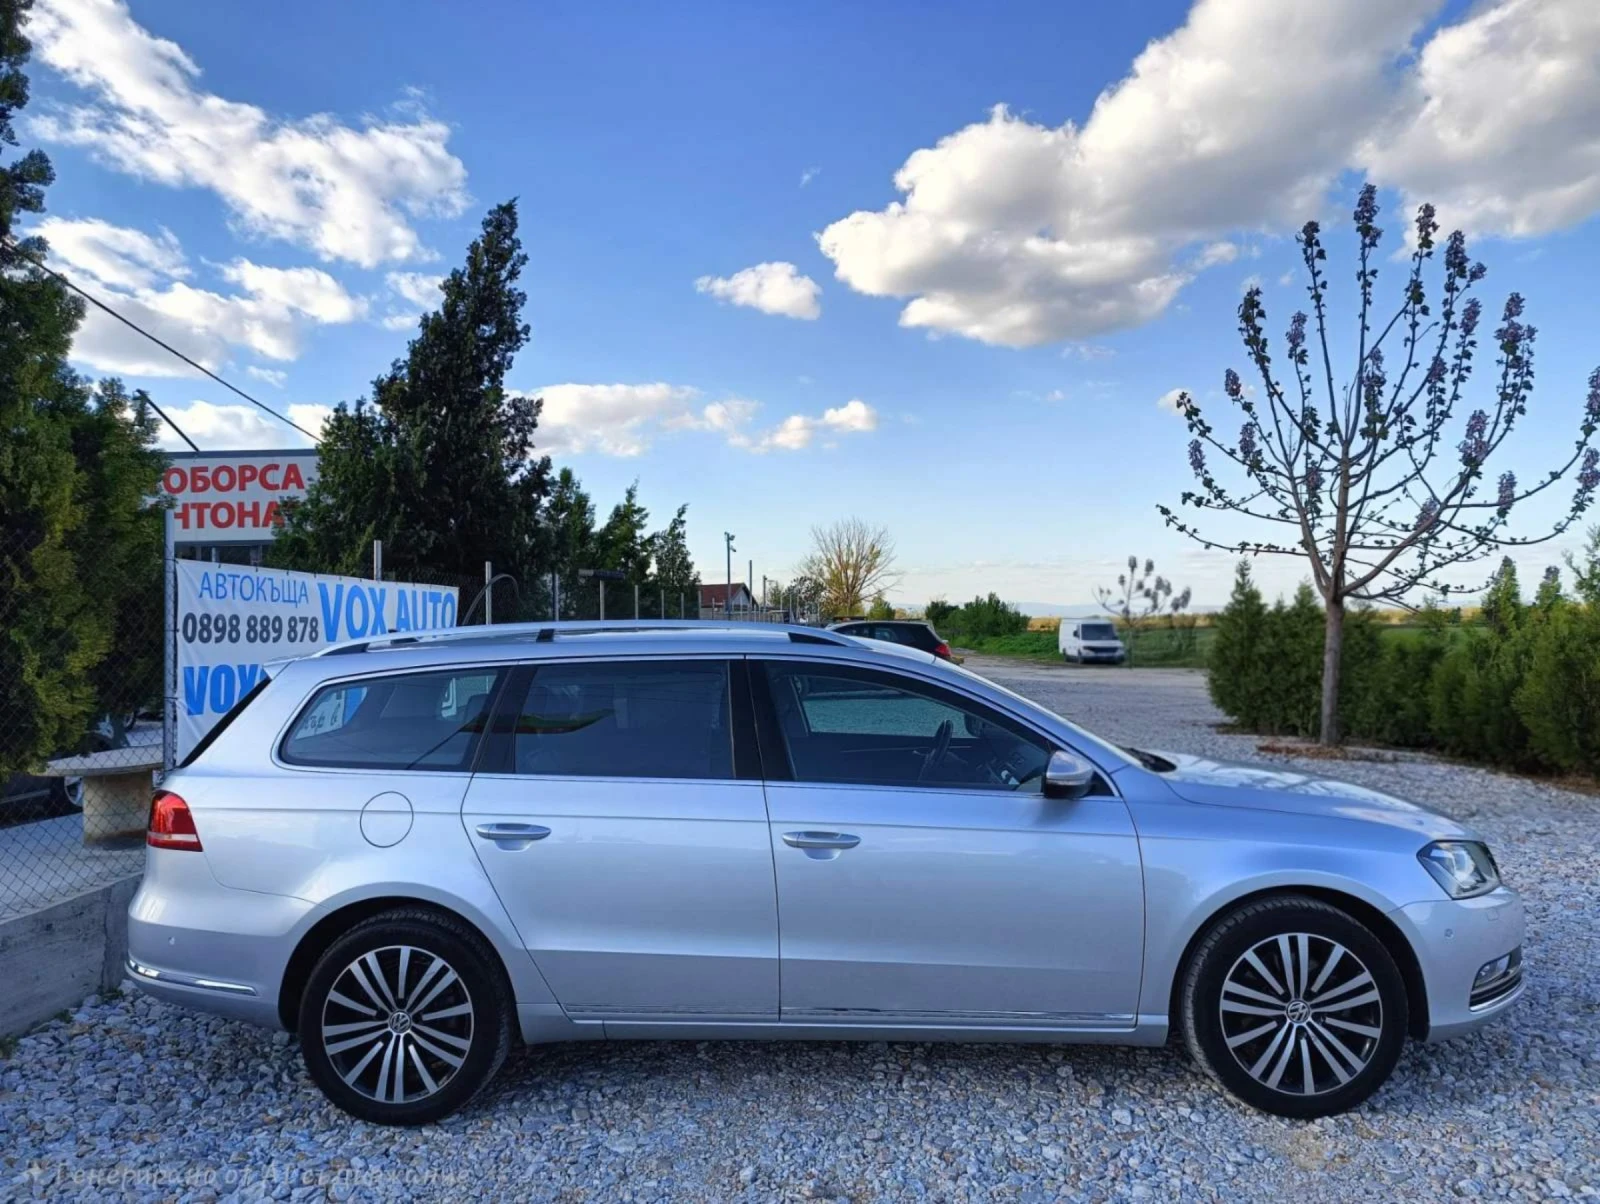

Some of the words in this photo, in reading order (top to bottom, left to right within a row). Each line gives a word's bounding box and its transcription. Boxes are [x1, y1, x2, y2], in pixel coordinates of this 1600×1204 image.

[162, 463, 305, 494] ОБОРСА
[174, 501, 286, 529] НТОНА
[199, 572, 309, 608] АВТОКЪЩА
[182, 612, 241, 644] 0898
[246, 615, 283, 643] 889
[287, 616, 319, 643] 878
[317, 582, 387, 643] VOX
[396, 589, 456, 632] AUTO
[183, 664, 271, 716] VOX
